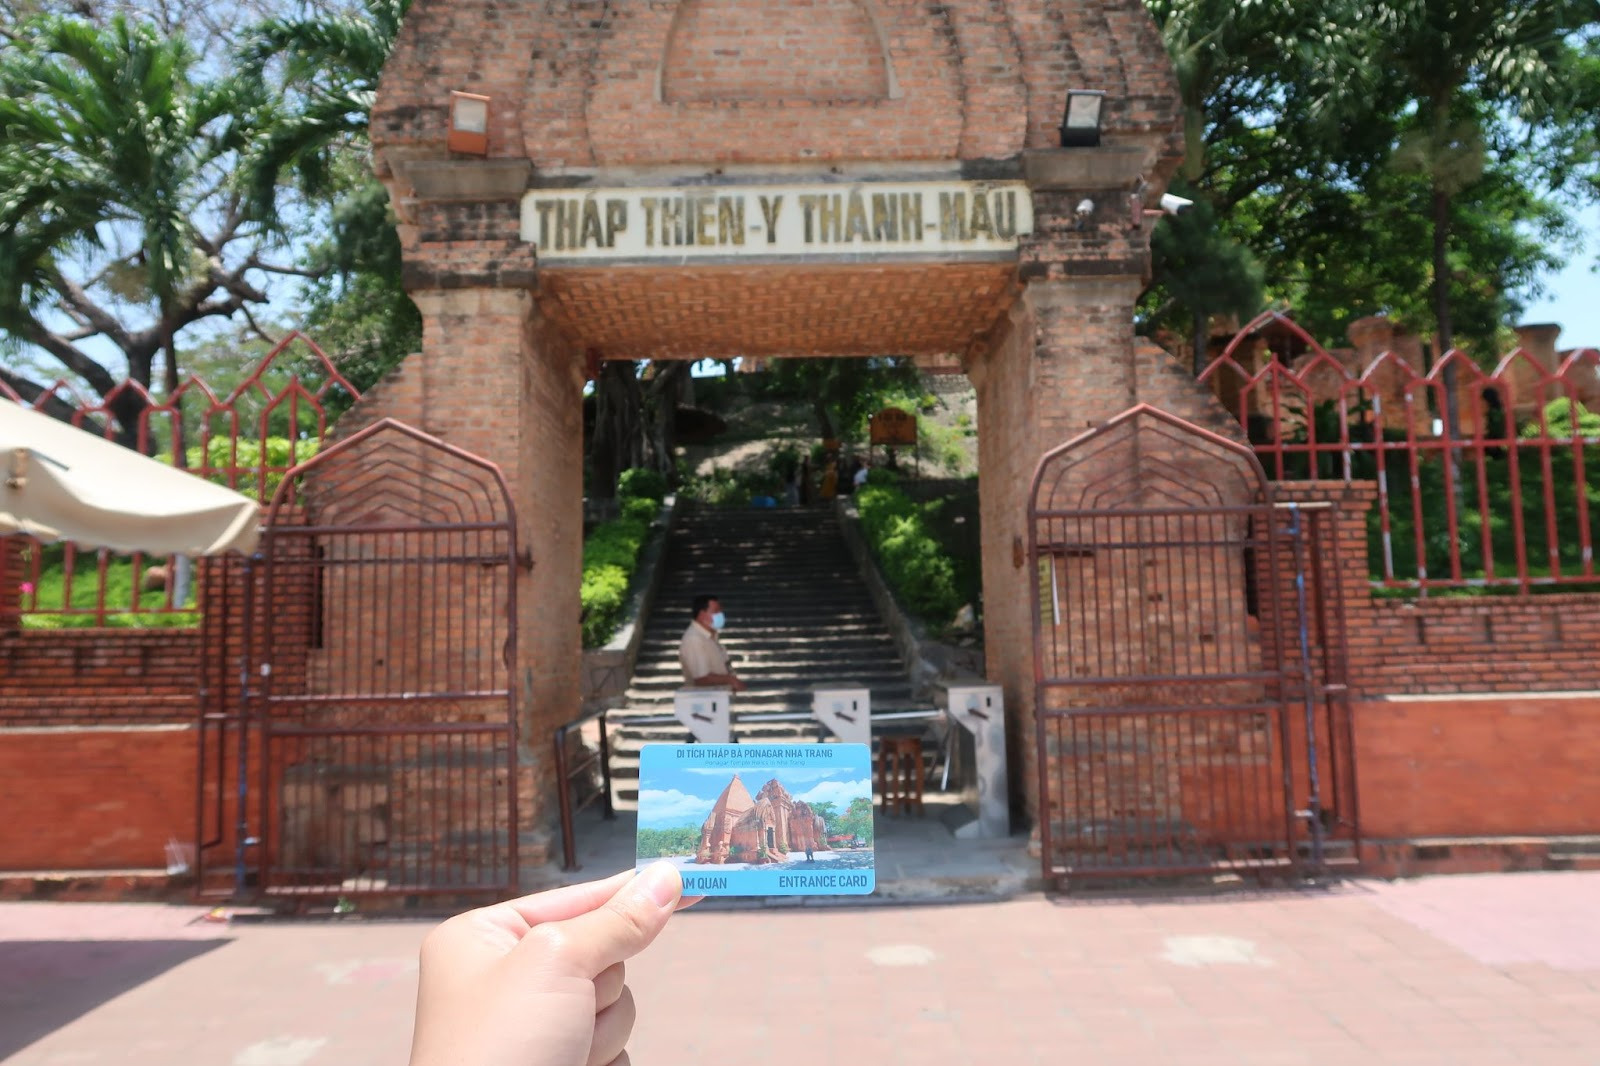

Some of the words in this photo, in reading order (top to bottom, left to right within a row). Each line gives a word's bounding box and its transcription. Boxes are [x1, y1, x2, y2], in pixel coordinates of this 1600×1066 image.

[676, 749, 685, 758] DI
[687, 747, 705, 758] TÍCH
[707, 747, 730, 758] THÁP
[744, 749, 784, 758] PONAGAR
[785, 749, 803, 758] NHA
[805, 748, 833, 758] TRANG
[697, 877, 727, 890] QUAN
[779, 875, 837, 888] ENTRANCE
[838, 875, 868, 887] CARD
